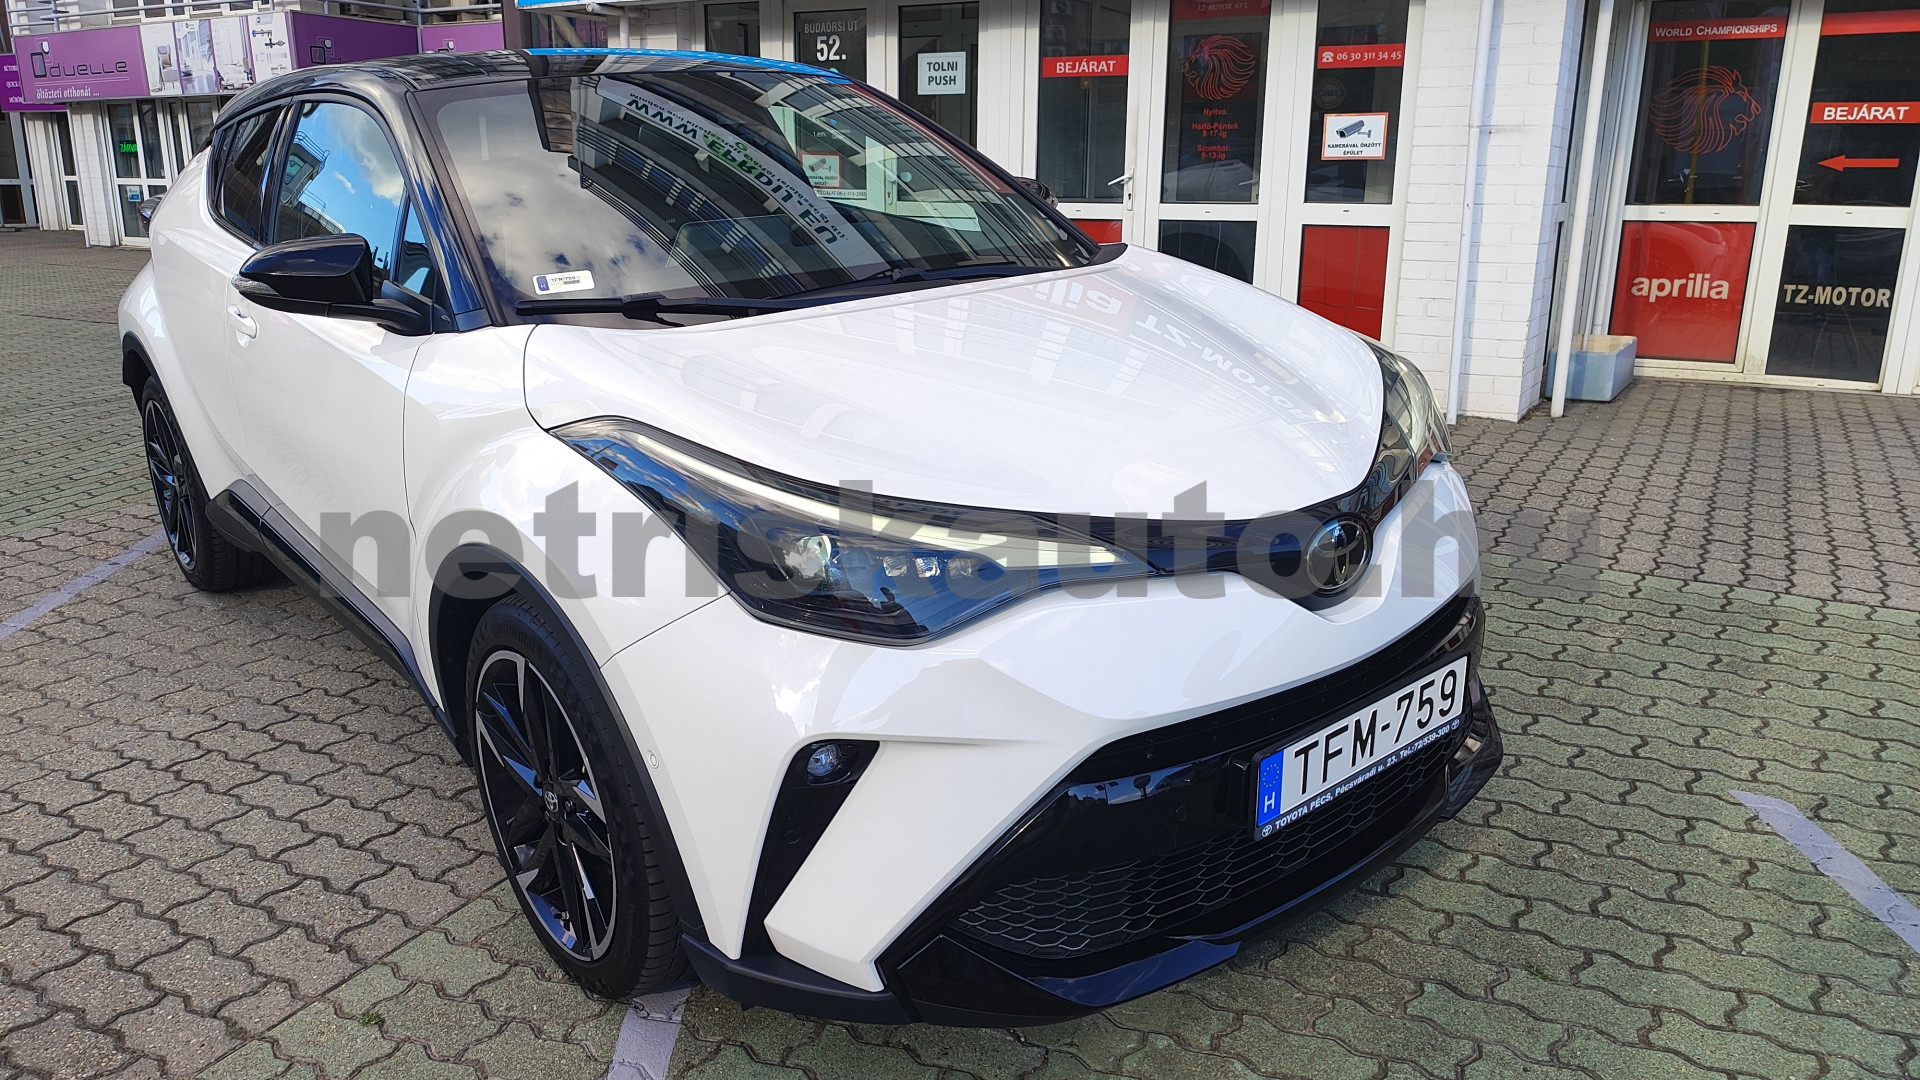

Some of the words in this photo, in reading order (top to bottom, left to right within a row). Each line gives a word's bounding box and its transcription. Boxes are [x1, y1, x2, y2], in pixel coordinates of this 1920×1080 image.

[1655, 27, 1693, 37] WORLD
[1696, 24, 1778, 36] CHAMPIONSHIPS
[816, 35, 847, 62] 52.
[1336, 52, 1348, 60] 06
[1350, 52, 1361, 62] 30
[1377, 51, 1389, 61] 34
[1390, 50, 1402, 60] 45
[926, 61, 958, 72] TOLNI
[1056, 58, 1117, 74] BEJÁRAT
[927, 75, 957, 86] PUSH
[1823, 103, 1909, 121] BEJÁRAT
[1631, 273, 1729, 302] aprilia
[1784, 284, 1891, 308] TZ-MOTOR
[1294, 669, 1457, 795] TFM-759
[1263, 791, 1275, 813] H
[1275, 805, 1308, 829] TOYOTA
